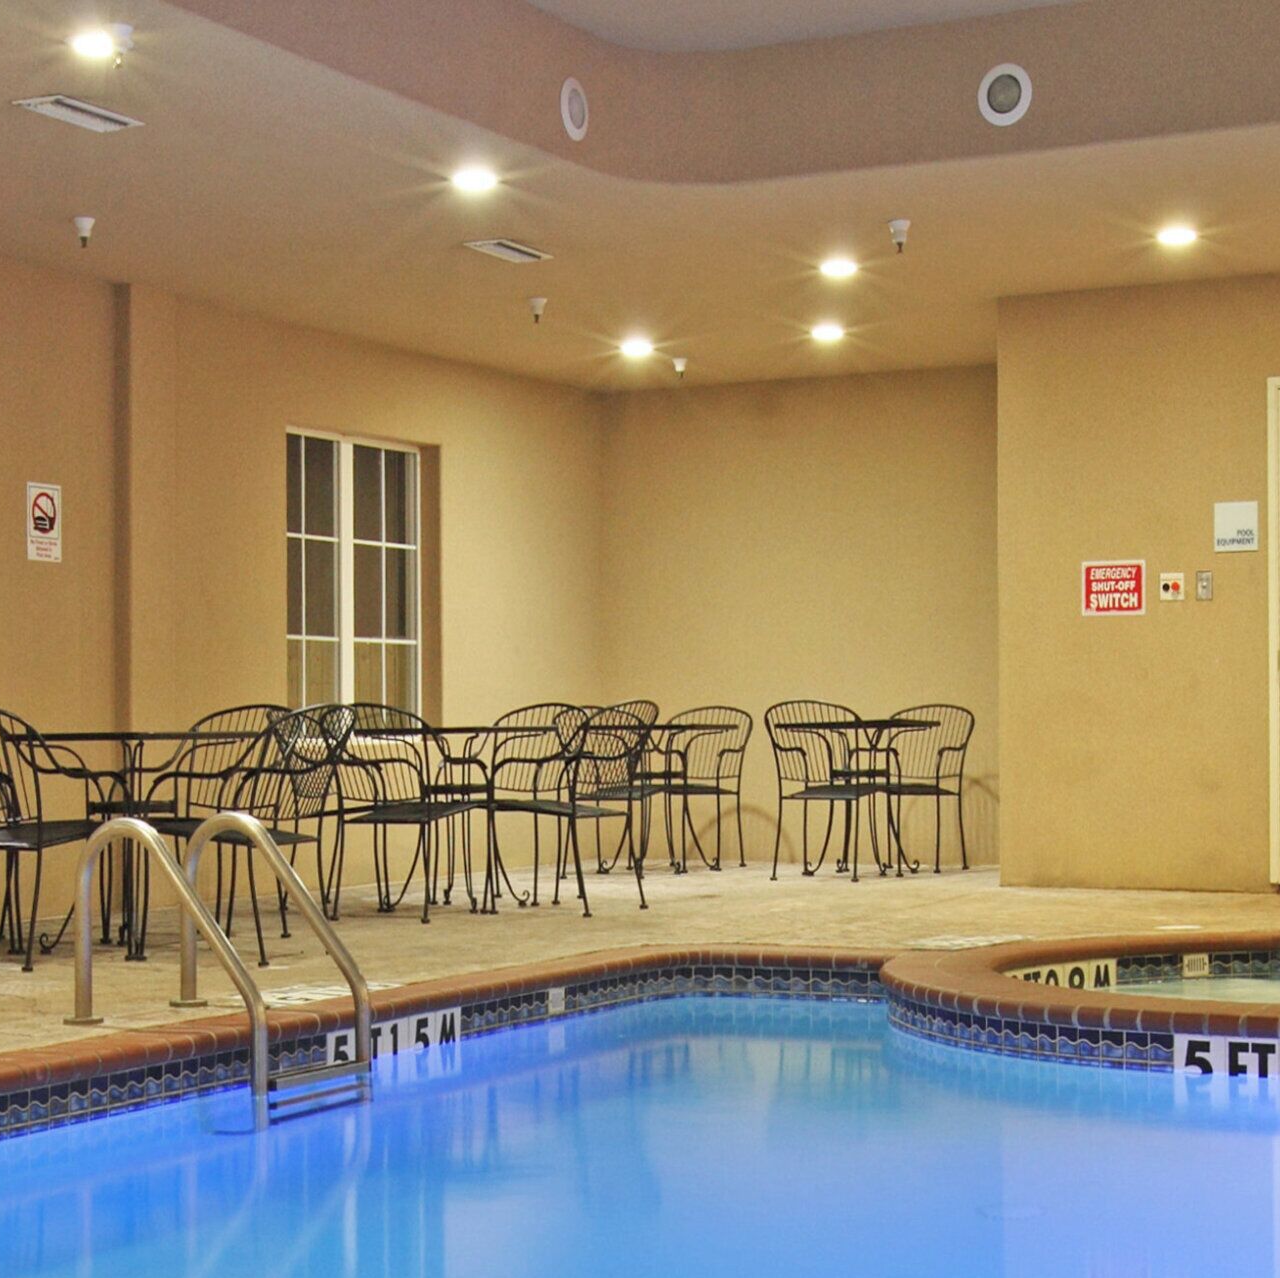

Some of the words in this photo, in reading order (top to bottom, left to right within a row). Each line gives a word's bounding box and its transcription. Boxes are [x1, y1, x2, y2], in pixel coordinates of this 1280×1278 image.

[1237, 529, 1254, 537] POOL
[1217, 537, 1254, 546] EQUIPMENT
[1090, 567, 1137, 580] EMERGENCY
[1091, 581, 1136, 591] SHUT-OFF
[1089, 592, 1138, 609] SWITCH
